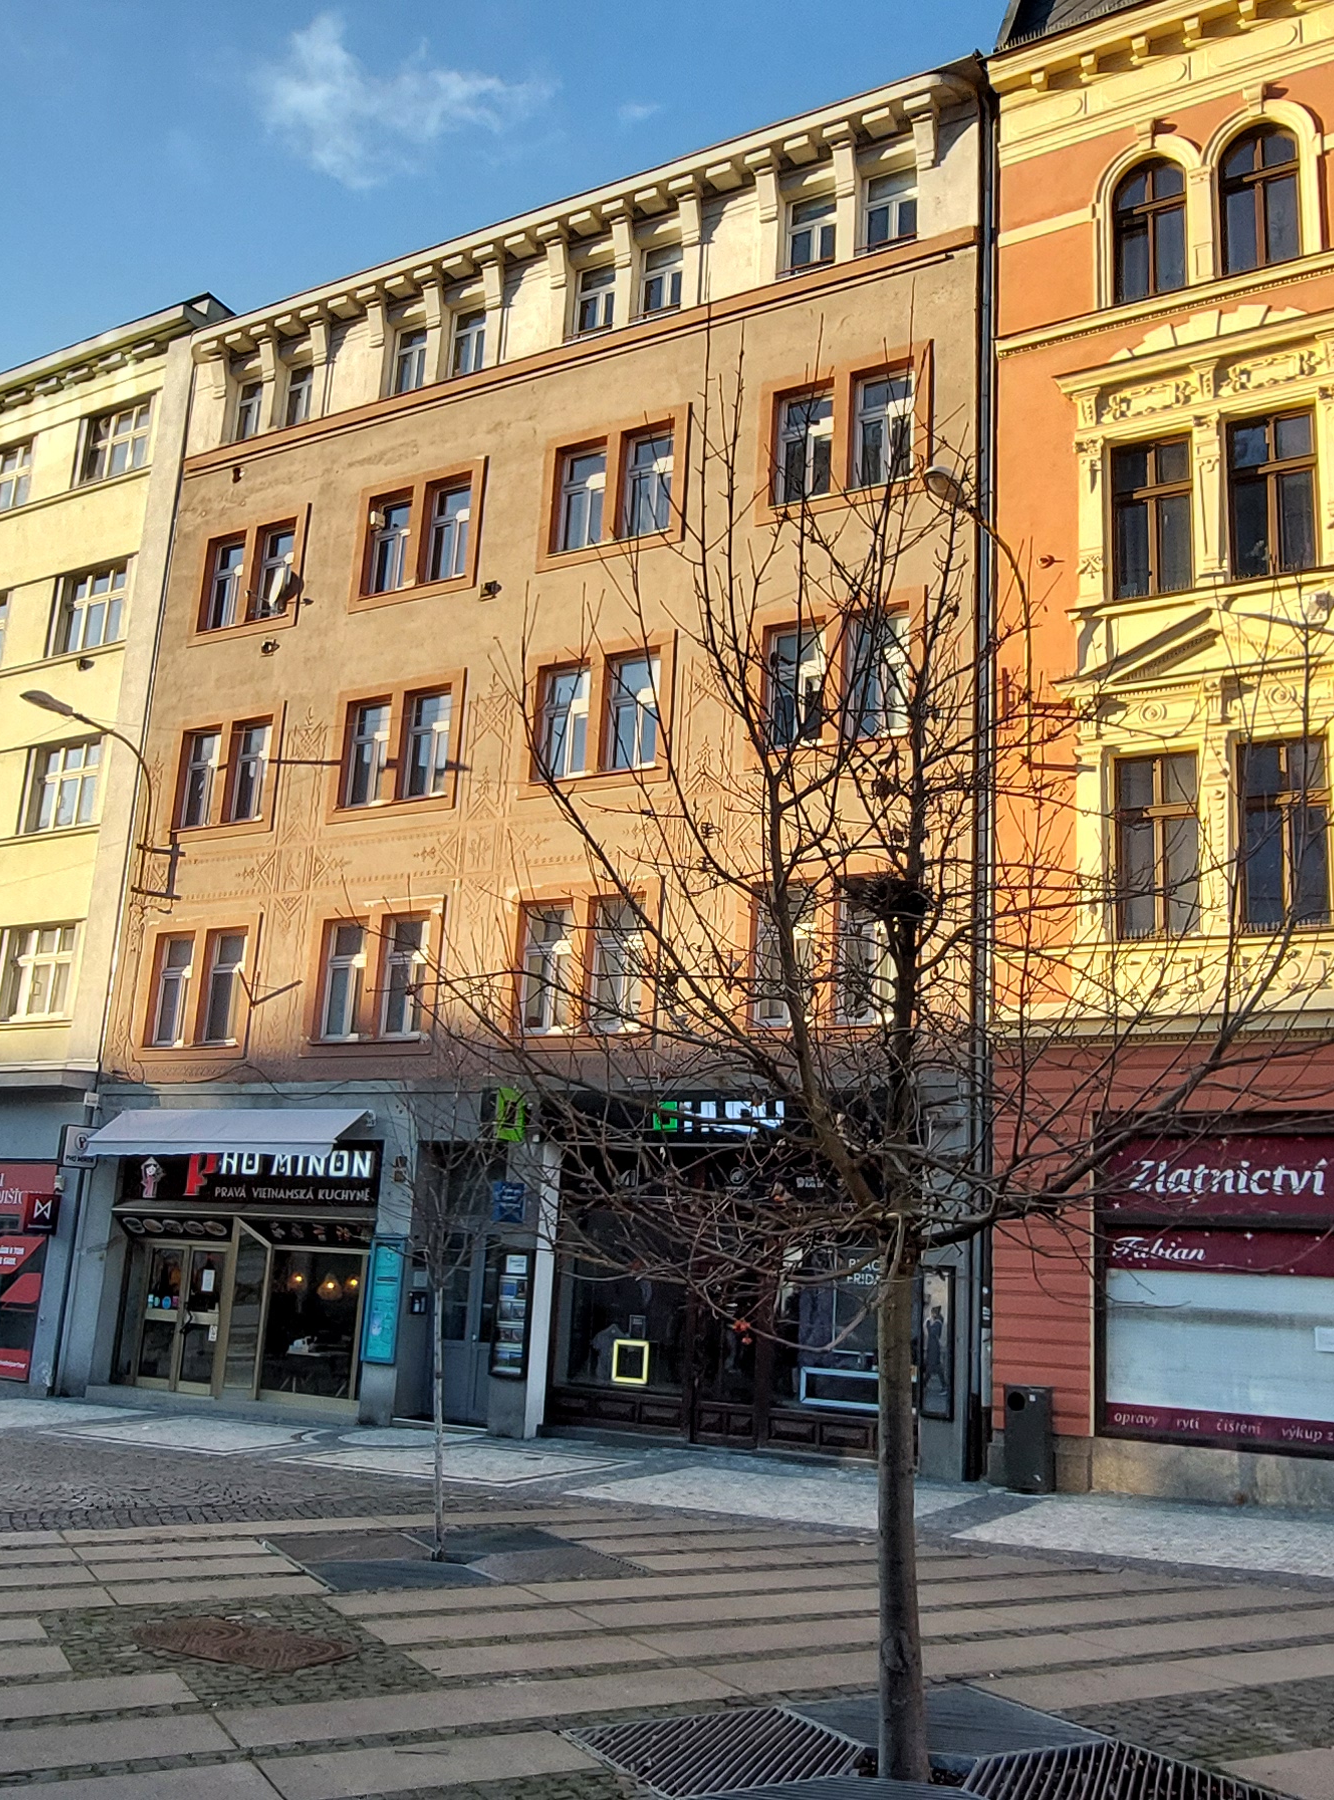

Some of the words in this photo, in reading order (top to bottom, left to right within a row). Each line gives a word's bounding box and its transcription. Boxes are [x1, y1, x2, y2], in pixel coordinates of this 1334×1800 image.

[270, 1150, 373, 1178] MINON
[1129, 1158, 1328, 1196] Zlatnictví
[214, 1184, 247, 1199] PRAVÁ
[252, 1185, 315, 1200] VIETNAMSKÁ
[1112, 1236, 1207, 1262] Fabian
[1113, 1411, 1159, 1430] opravy
[1176, 1416, 1201, 1431] rytí
[1216, 1417, 1262, 1435] čištění
[1281, 1425, 1323, 1443] výkup
